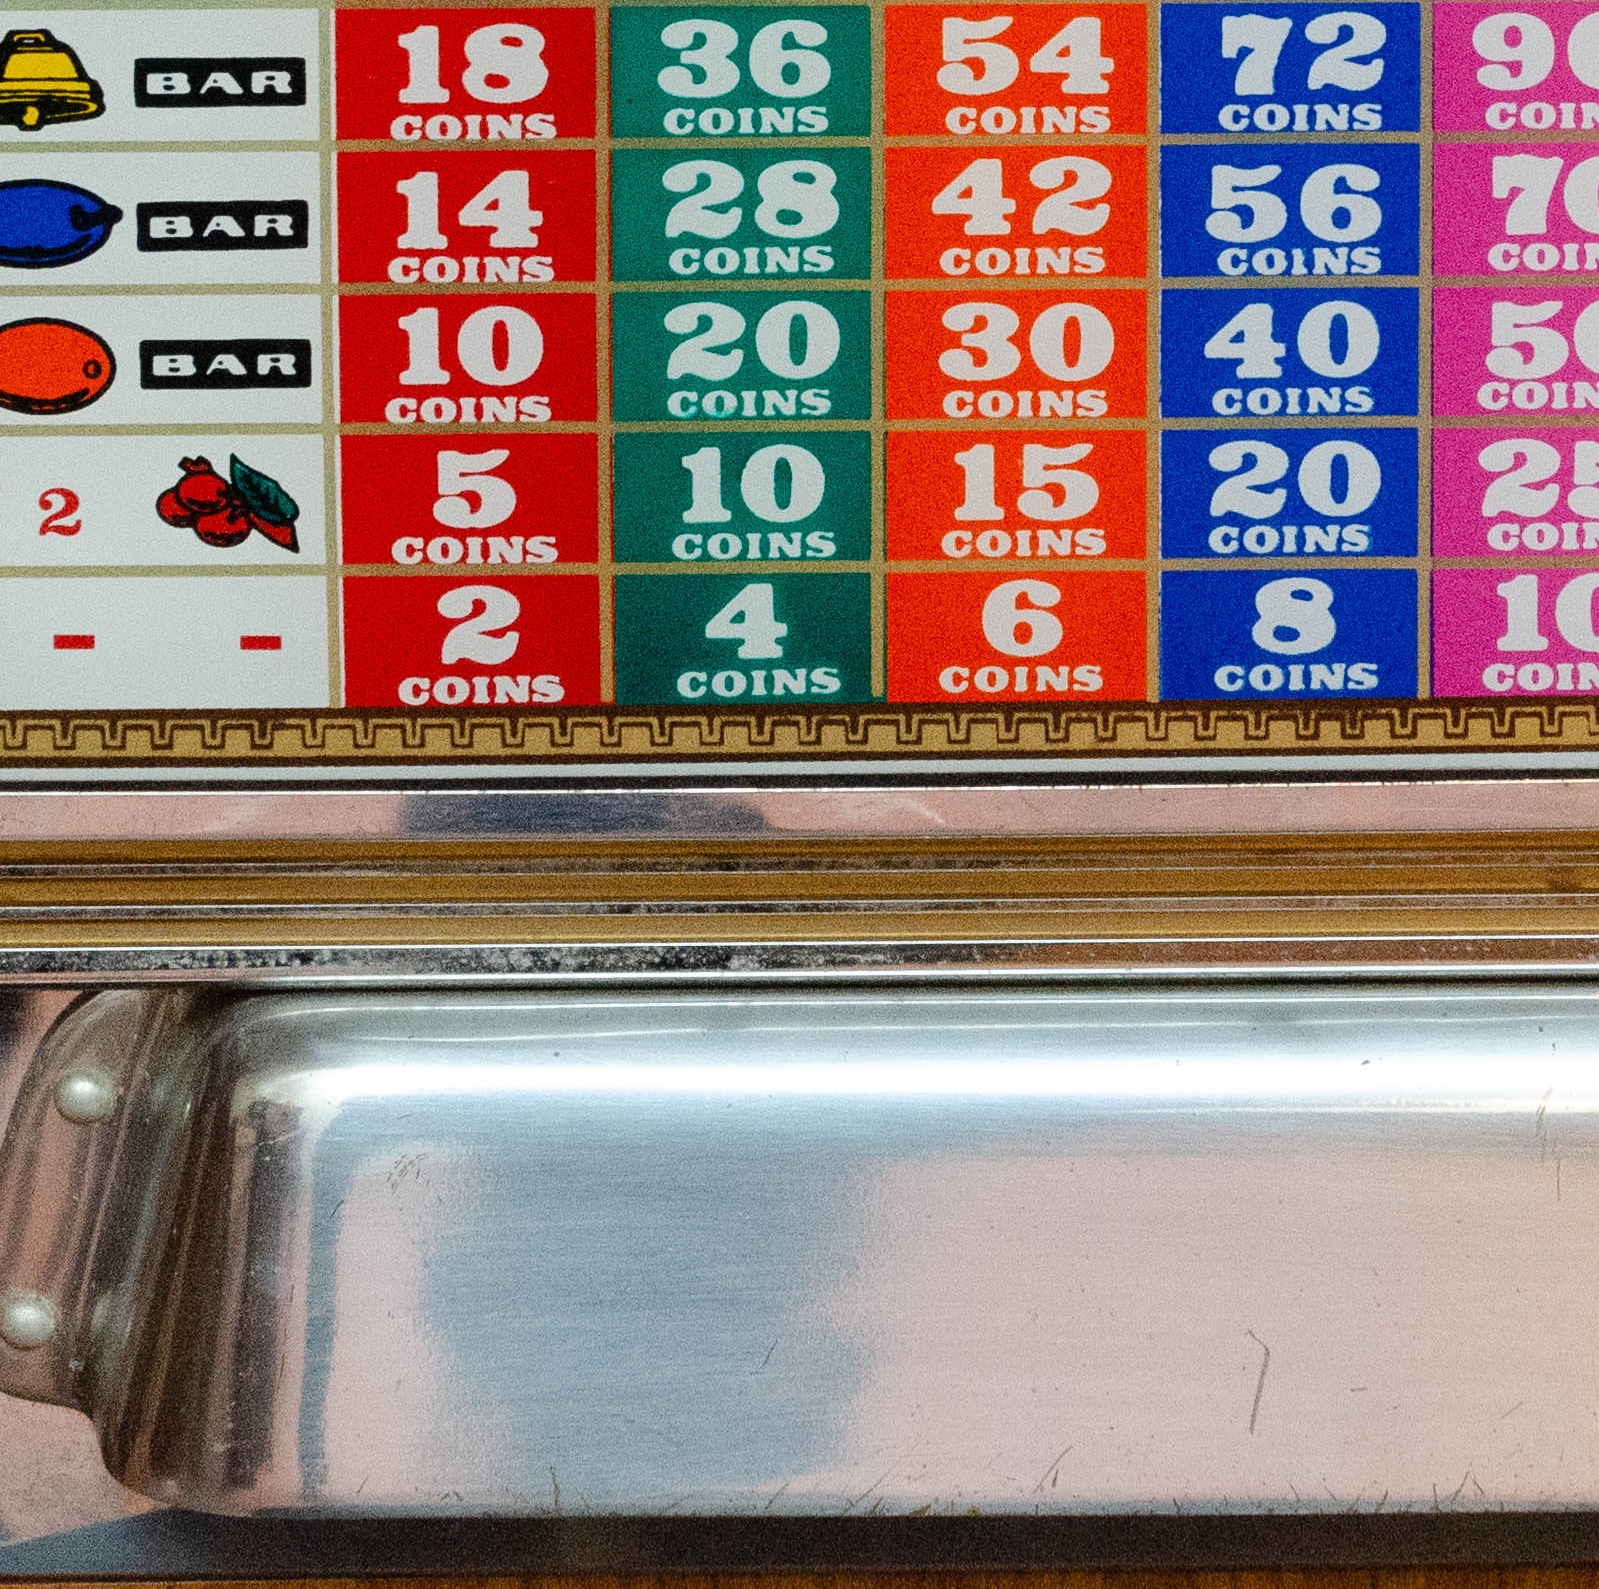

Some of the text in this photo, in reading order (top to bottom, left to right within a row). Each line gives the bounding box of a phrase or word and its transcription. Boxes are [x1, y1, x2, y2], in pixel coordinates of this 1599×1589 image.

[400, 24, 547, 102] 18
[659, 20, 829, 96] 36
[939, 18, 1113, 94] 54
[1223, 13, 1385, 94] 72
[146, 70, 293, 96] BAR
[392, 113, 555, 142] COINS
[665, 107, 827, 135] COINS
[947, 107, 1109, 135] COINS
[1220, 104, 1380, 132] COINS
[398, 171, 542, 248] 14
[664, 161, 838, 237] 28
[934, 157, 1110, 234] 42
[1207, 165, 1381, 241] 56
[149, 213, 294, 239] BAR
[389, 256, 553, 285] COINS
[671, 246, 832, 275] COINS
[942, 247, 1103, 276] COINS
[1219, 247, 1379, 277] COINS
[400, 307, 542, 385] 10
[665, 302, 839, 379] 20
[940, 304, 1113, 380] 30
[1206, 302, 1378, 377] 40
[152, 352, 297, 377] BAR
[386, 396, 550, 425] COINS
[669, 389, 829, 416] COINS
[945, 390, 1106, 419] COINS
[1213, 387, 1372, 416] COINS
[434, 450, 515, 527] 5
[683, 445, 824, 522] 10
[956, 445, 1097, 519] 15
[1210, 441, 1380, 518] 20
[37, 486, 83, 538] 2
[393, 536, 557, 566] COINS
[674, 532, 834, 560] COINS
[943, 529, 1105, 558] COINS
[1210, 524, 1367, 554] COINS
[438, 586, 519, 664] 2
[707, 585, 786, 657] 4
[984, 581, 1061, 655] 6
[1253, 579, 1334, 653] 8
[400, 675, 563, 706] COINS
[679, 668, 839, 698] COINS
[941, 666, 1101, 693] COINS
[1216, 663, 1376, 692] COINS
